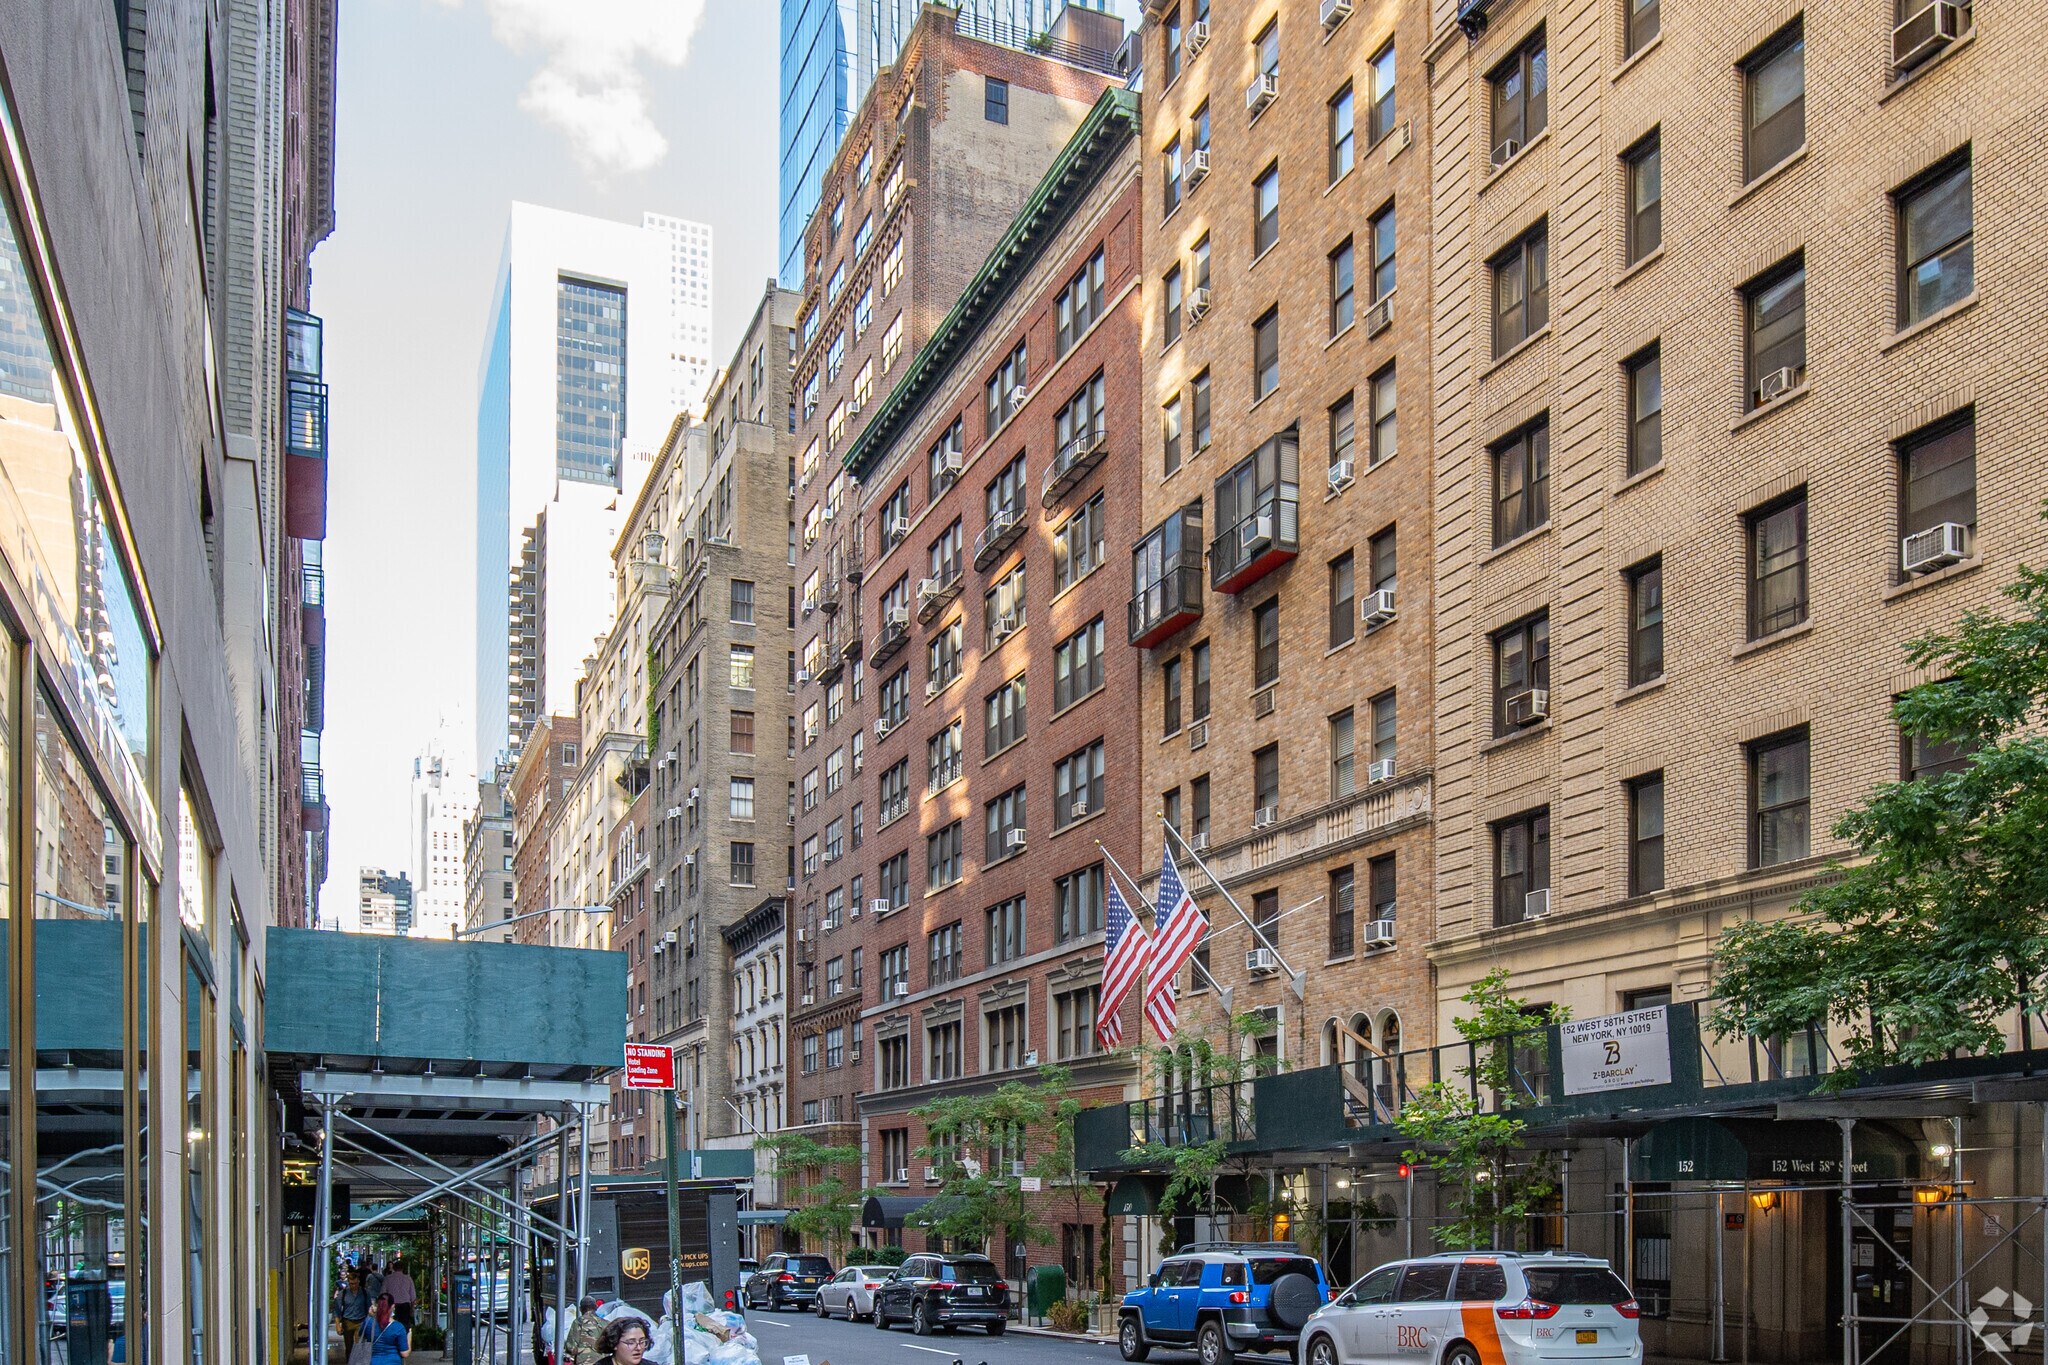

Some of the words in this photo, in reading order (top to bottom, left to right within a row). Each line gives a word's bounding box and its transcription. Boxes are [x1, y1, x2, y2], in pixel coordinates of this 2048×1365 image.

[1562, 1025, 1576, 1034] 152
[1578, 1020, 1601, 1032] WEST
[1604, 1016, 1625, 1028] 58TH
[1628, 1009, 1663, 1023] STREET
[1572, 1034, 1589, 1044] NEW
[1592, 1030, 1614, 1040] YORK,
[1616, 1028, 1627, 1036] NY
[1629, 1024, 1651, 1034] 10019
[628, 1048, 636, 1056] NO
[637, 1048, 666, 1058] STANDING
[628, 1066, 646, 1075] Loading
[1678, 1160, 1694, 1173] 152
[1772, 1160, 1787, 1173] 152
[1792, 1160, 1814, 1172] West
[1820, 1160, 1835, 1172] 58th
[1838, 1161, 1868, 1173] Sreet
[1123, 1203, 1132, 1212] 150
[624, 1257, 648, 1275] ups
[1397, 1326, 1428, 1348] BRC
[1536, 1328, 1554, 1336] BRC
